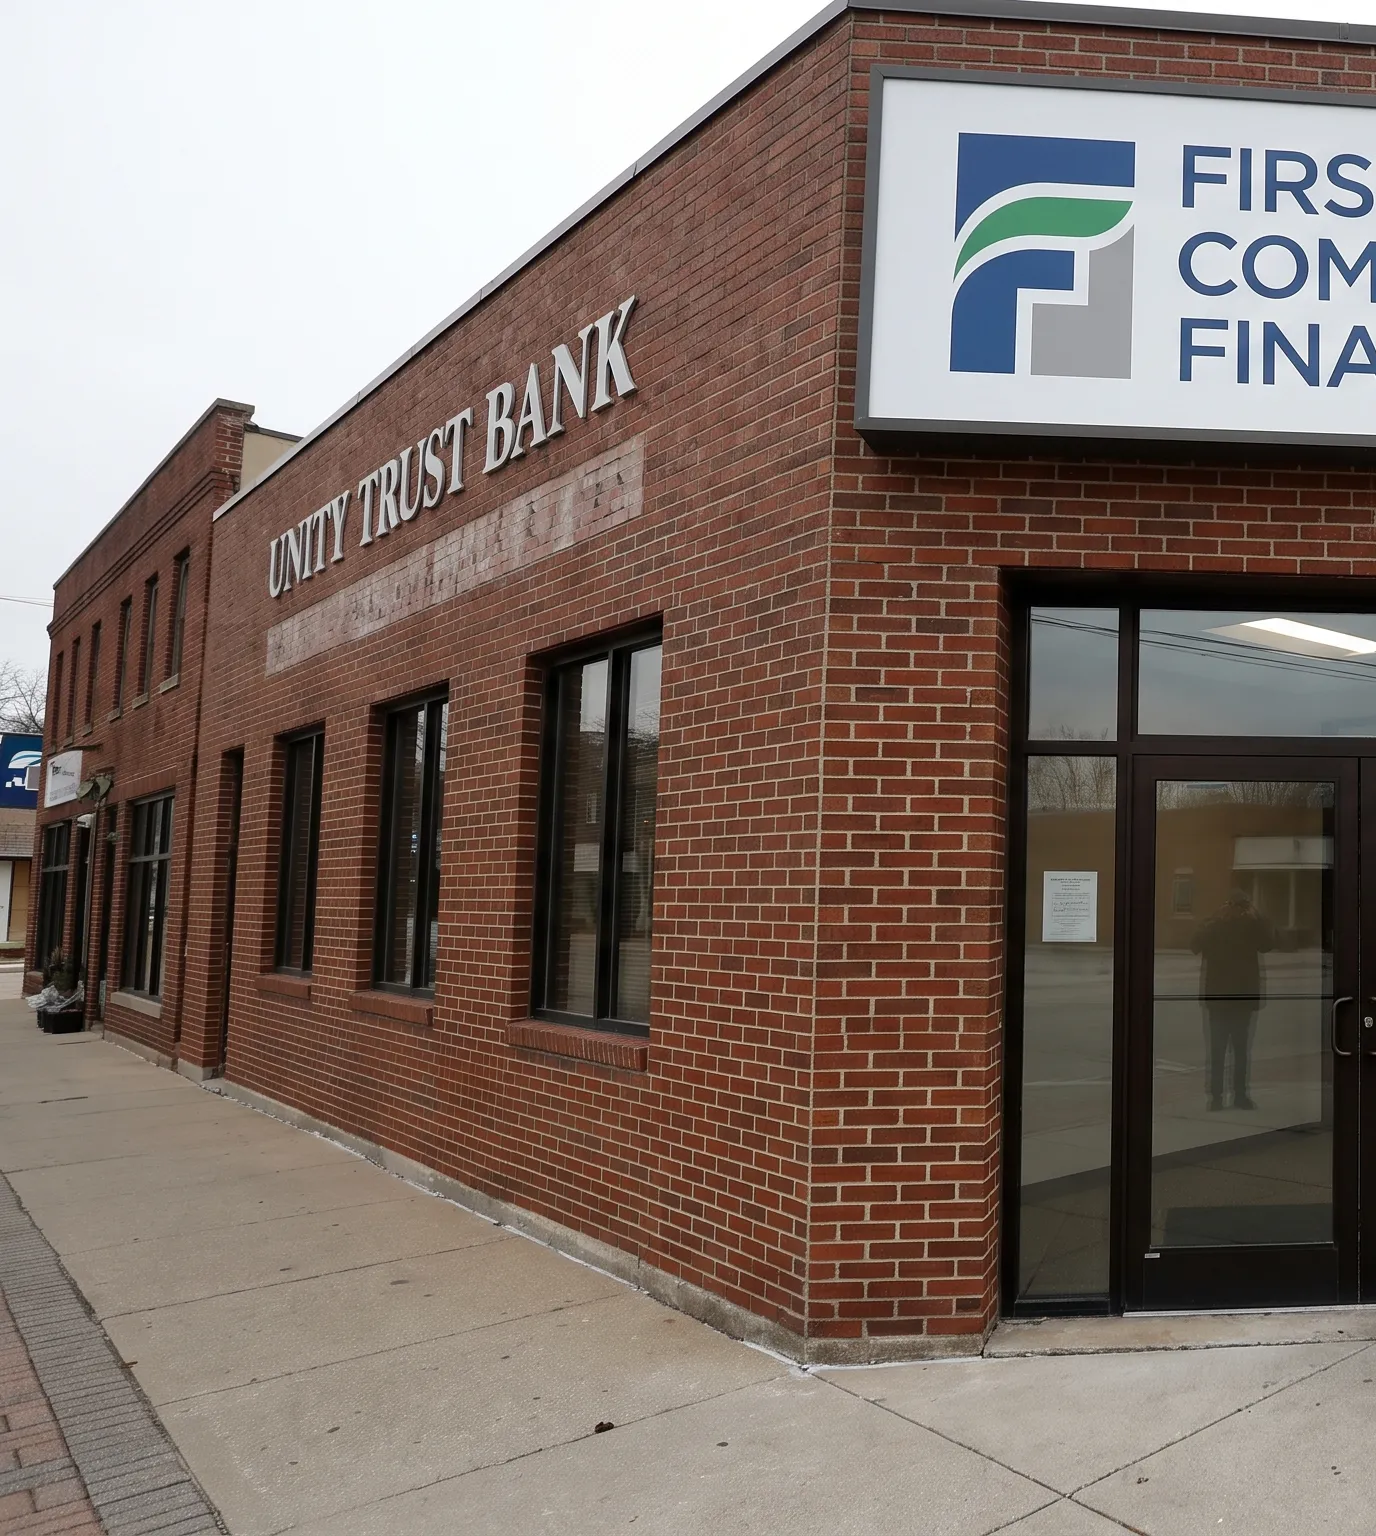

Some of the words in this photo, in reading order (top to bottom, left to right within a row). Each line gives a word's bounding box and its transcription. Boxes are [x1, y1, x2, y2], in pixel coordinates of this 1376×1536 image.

[268, 490, 351, 599] UNITY
[357, 407, 474, 547] TRUST
[481, 294, 640, 475] BANK
